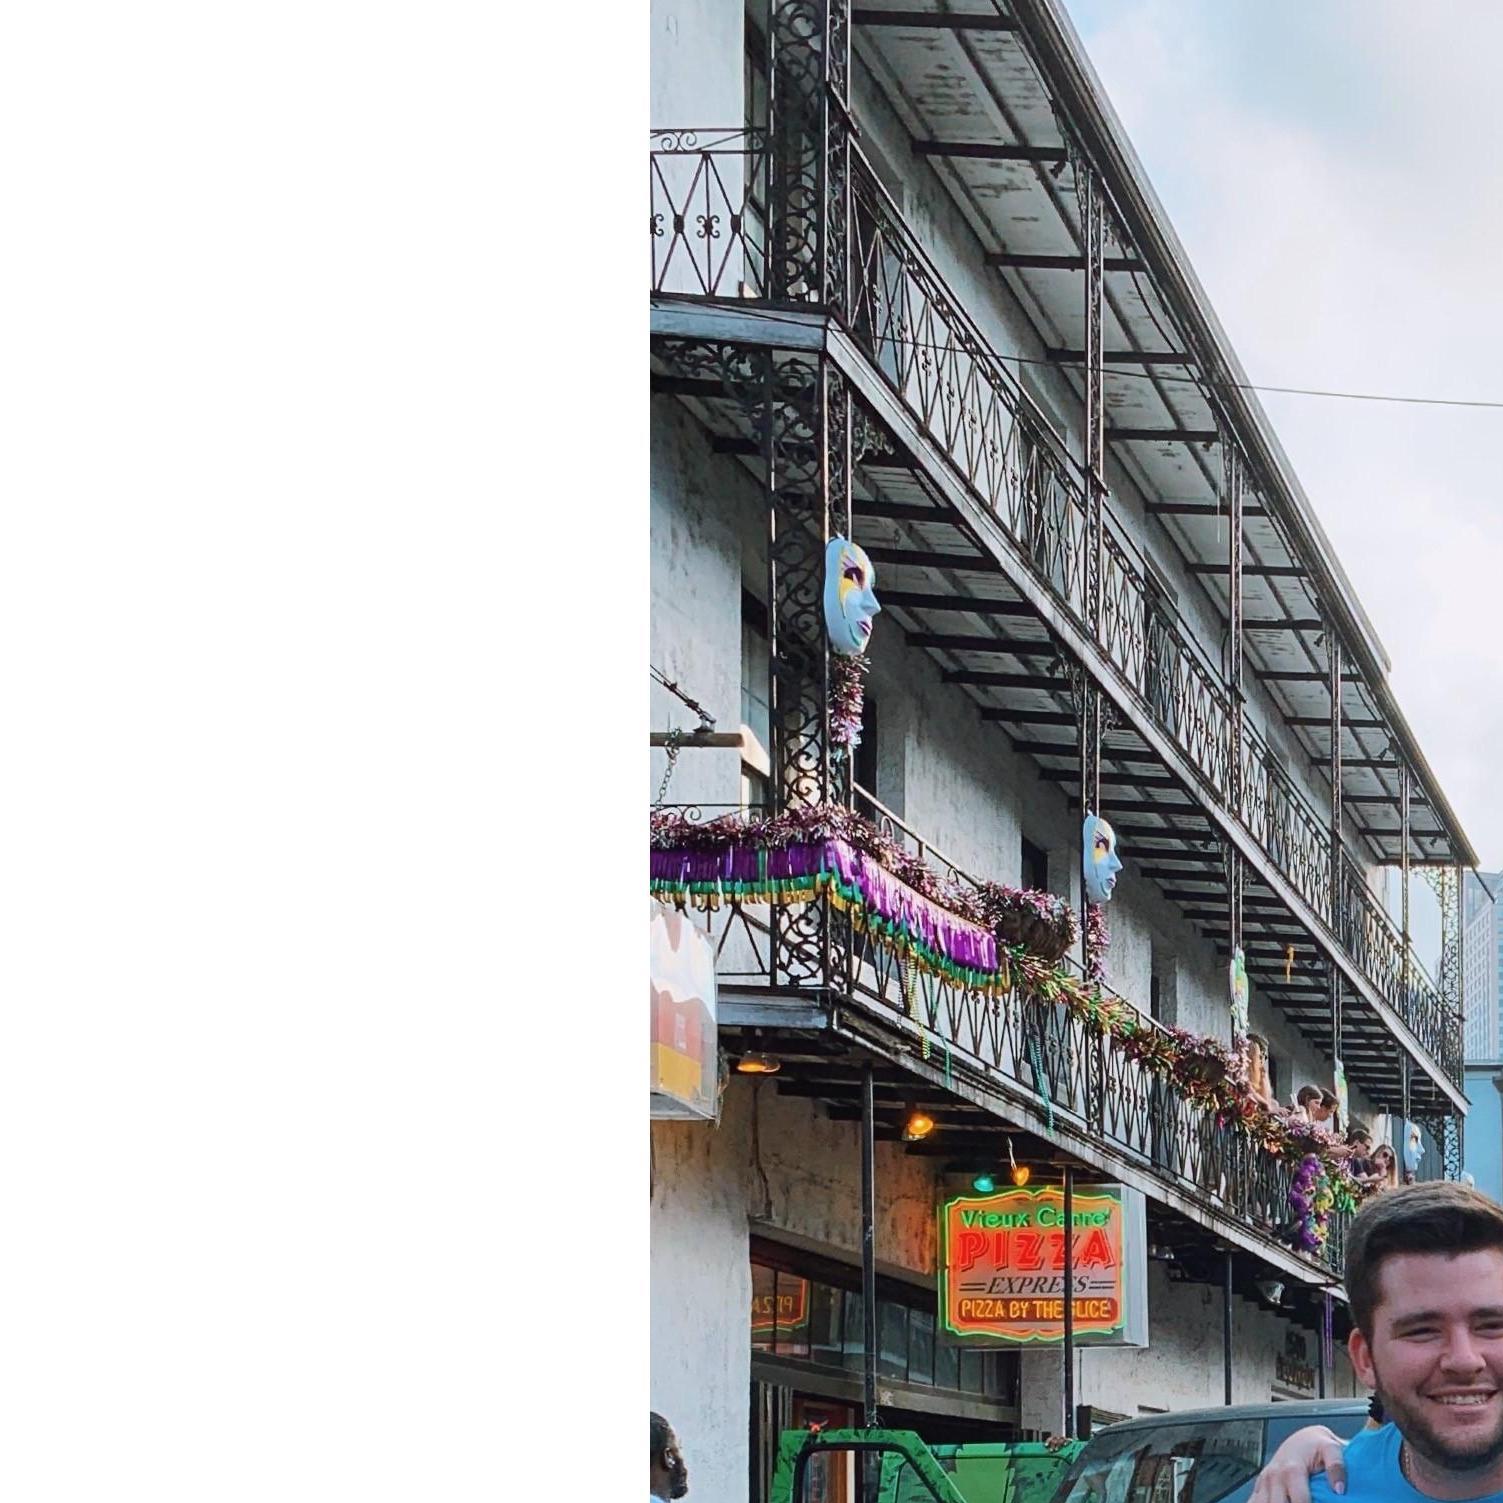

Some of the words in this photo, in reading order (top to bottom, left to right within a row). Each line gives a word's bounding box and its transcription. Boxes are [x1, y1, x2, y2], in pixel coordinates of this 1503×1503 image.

[961, 1209, 1030, 1229] Vieux
[958, 1230, 1116, 1272] PIZZA
[986, 1275, 1089, 1294] EXPRES
[961, 1300, 1005, 1318] PIZZA
[1009, 1300, 1030, 1318] BY
[1032, 1300, 1064, 1318] THE
